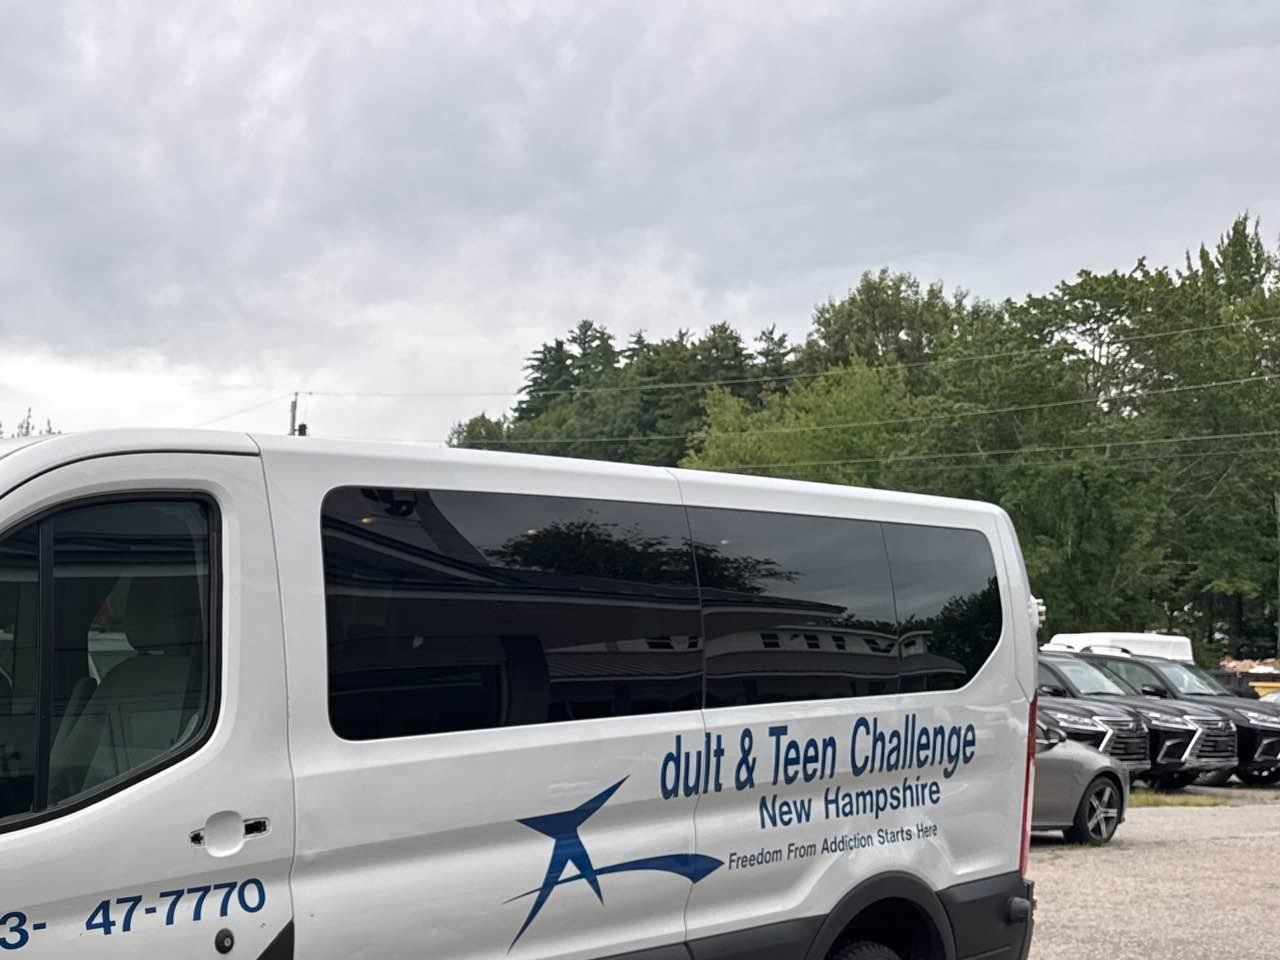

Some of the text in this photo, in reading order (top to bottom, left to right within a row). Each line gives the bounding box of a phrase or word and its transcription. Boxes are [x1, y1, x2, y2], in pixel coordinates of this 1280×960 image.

[660, 714, 976, 800] dult & Teen Challenge
[758, 776, 941, 830] New Hampshire
[728, 822, 938, 871] Freedom From Addiction Starts Here
[85, 877, 266, 936] 47-7770
